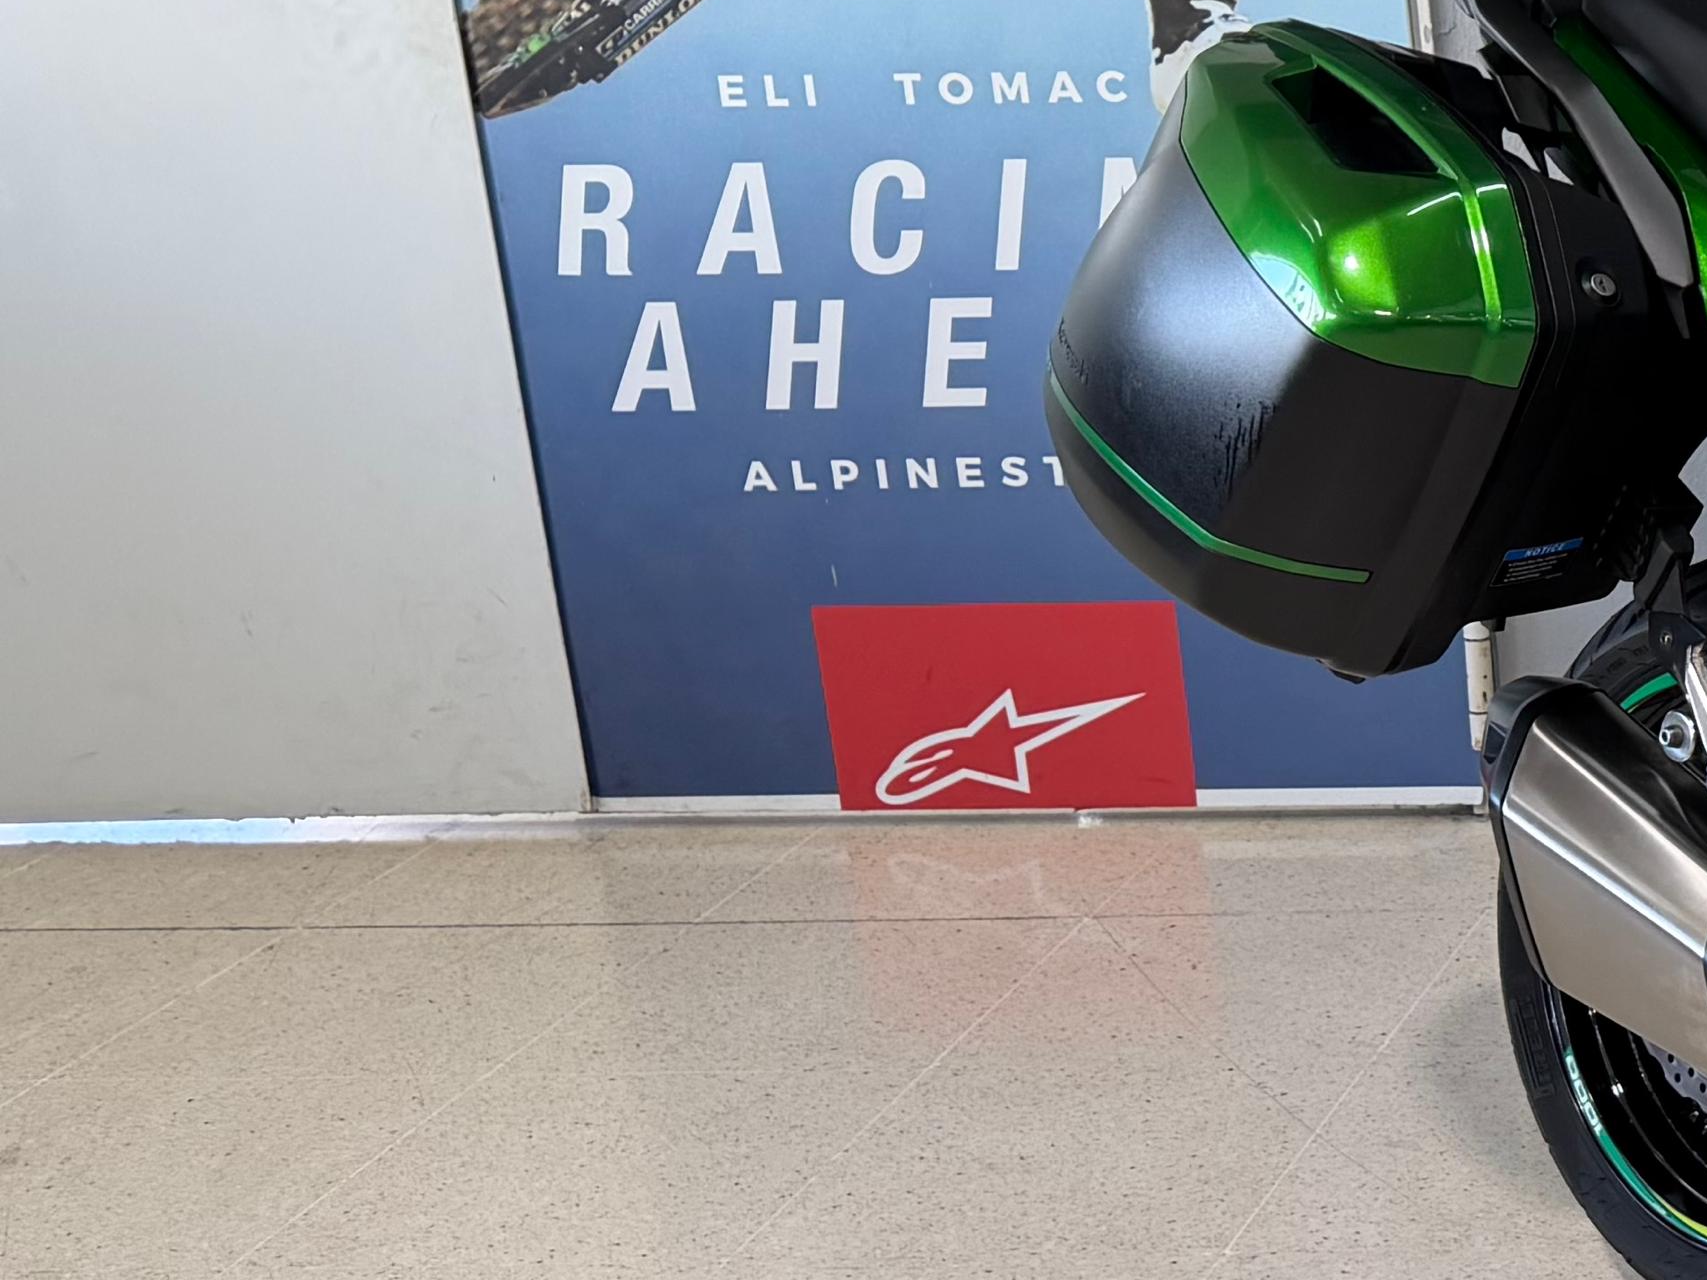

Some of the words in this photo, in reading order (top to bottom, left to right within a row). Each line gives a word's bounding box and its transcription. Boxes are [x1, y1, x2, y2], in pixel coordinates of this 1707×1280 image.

[718, 74, 818, 108] ELI
[894, 69, 1128, 105] TOMAC
[611, 296, 993, 412] AHE
[743, 456, 1065, 492] ALPINEST
[1524, 543, 1565, 558] NOTICE
